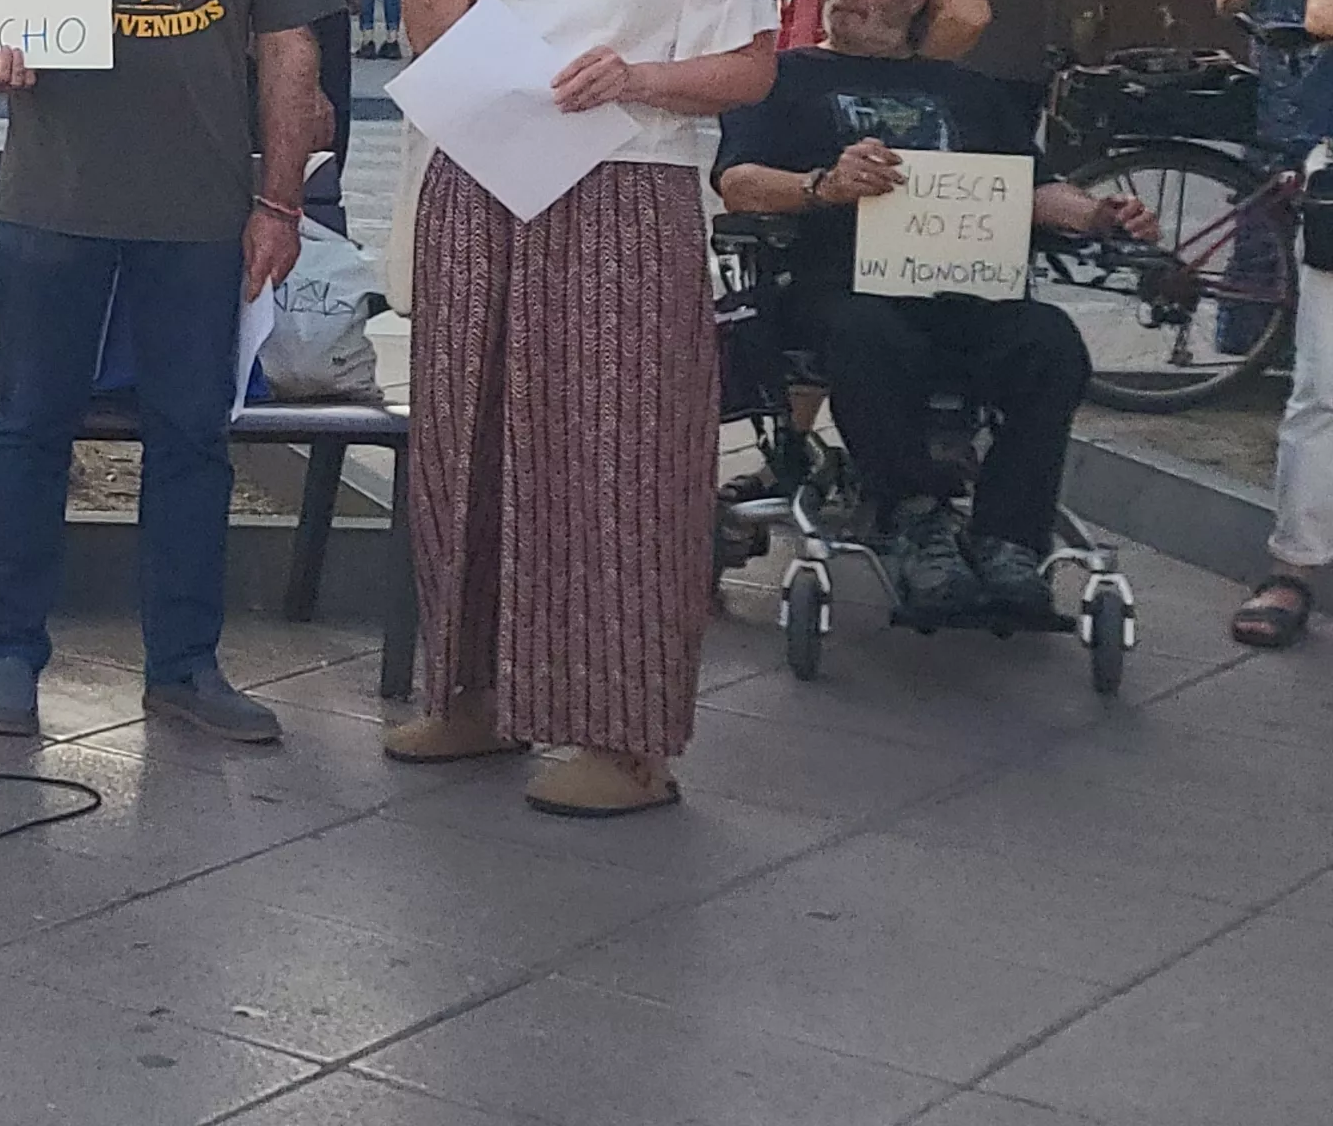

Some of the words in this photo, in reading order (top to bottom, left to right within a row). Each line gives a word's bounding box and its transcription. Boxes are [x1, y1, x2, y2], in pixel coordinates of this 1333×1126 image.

[905, 212, 945, 236] NO
[957, 214, 994, 241] ES
[860, 258, 888, 277] UN
[900, 257, 1025, 292] MONOPOLY
